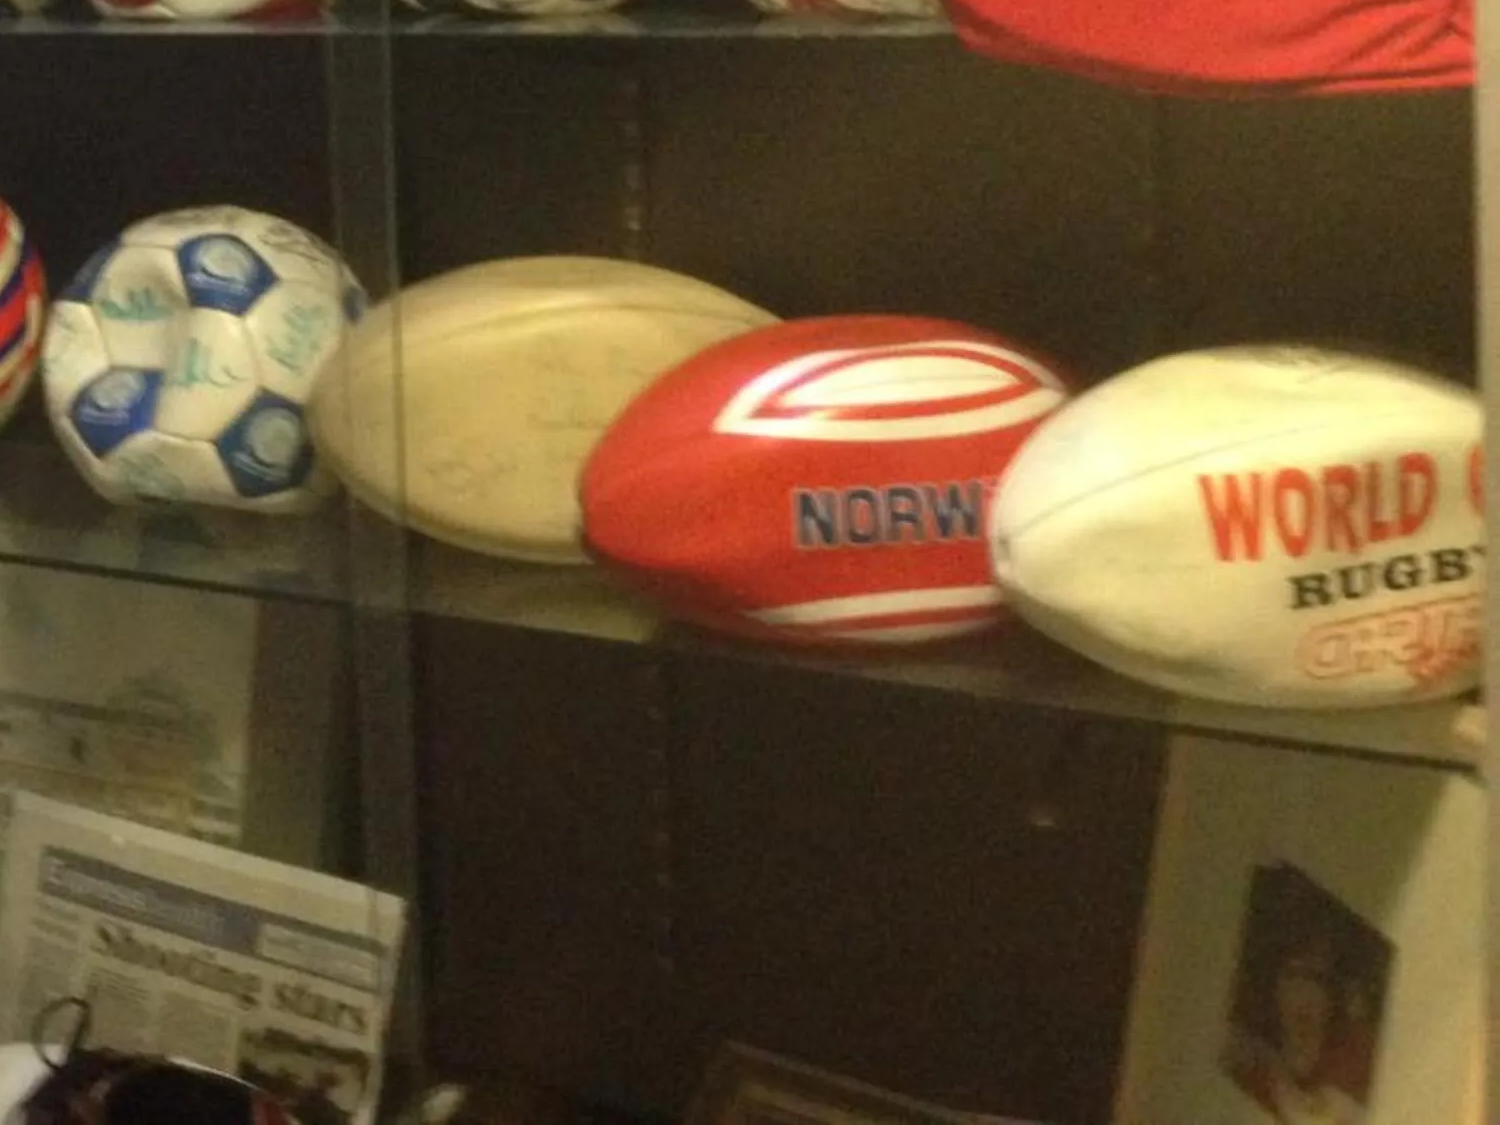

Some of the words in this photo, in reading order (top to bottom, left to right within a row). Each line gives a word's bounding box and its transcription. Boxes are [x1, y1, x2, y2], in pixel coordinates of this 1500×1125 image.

[791, 479, 999, 551] NORW
[1197, 452, 1438, 563] WORLD
[1286, 545, 1485, 610] RUGB
